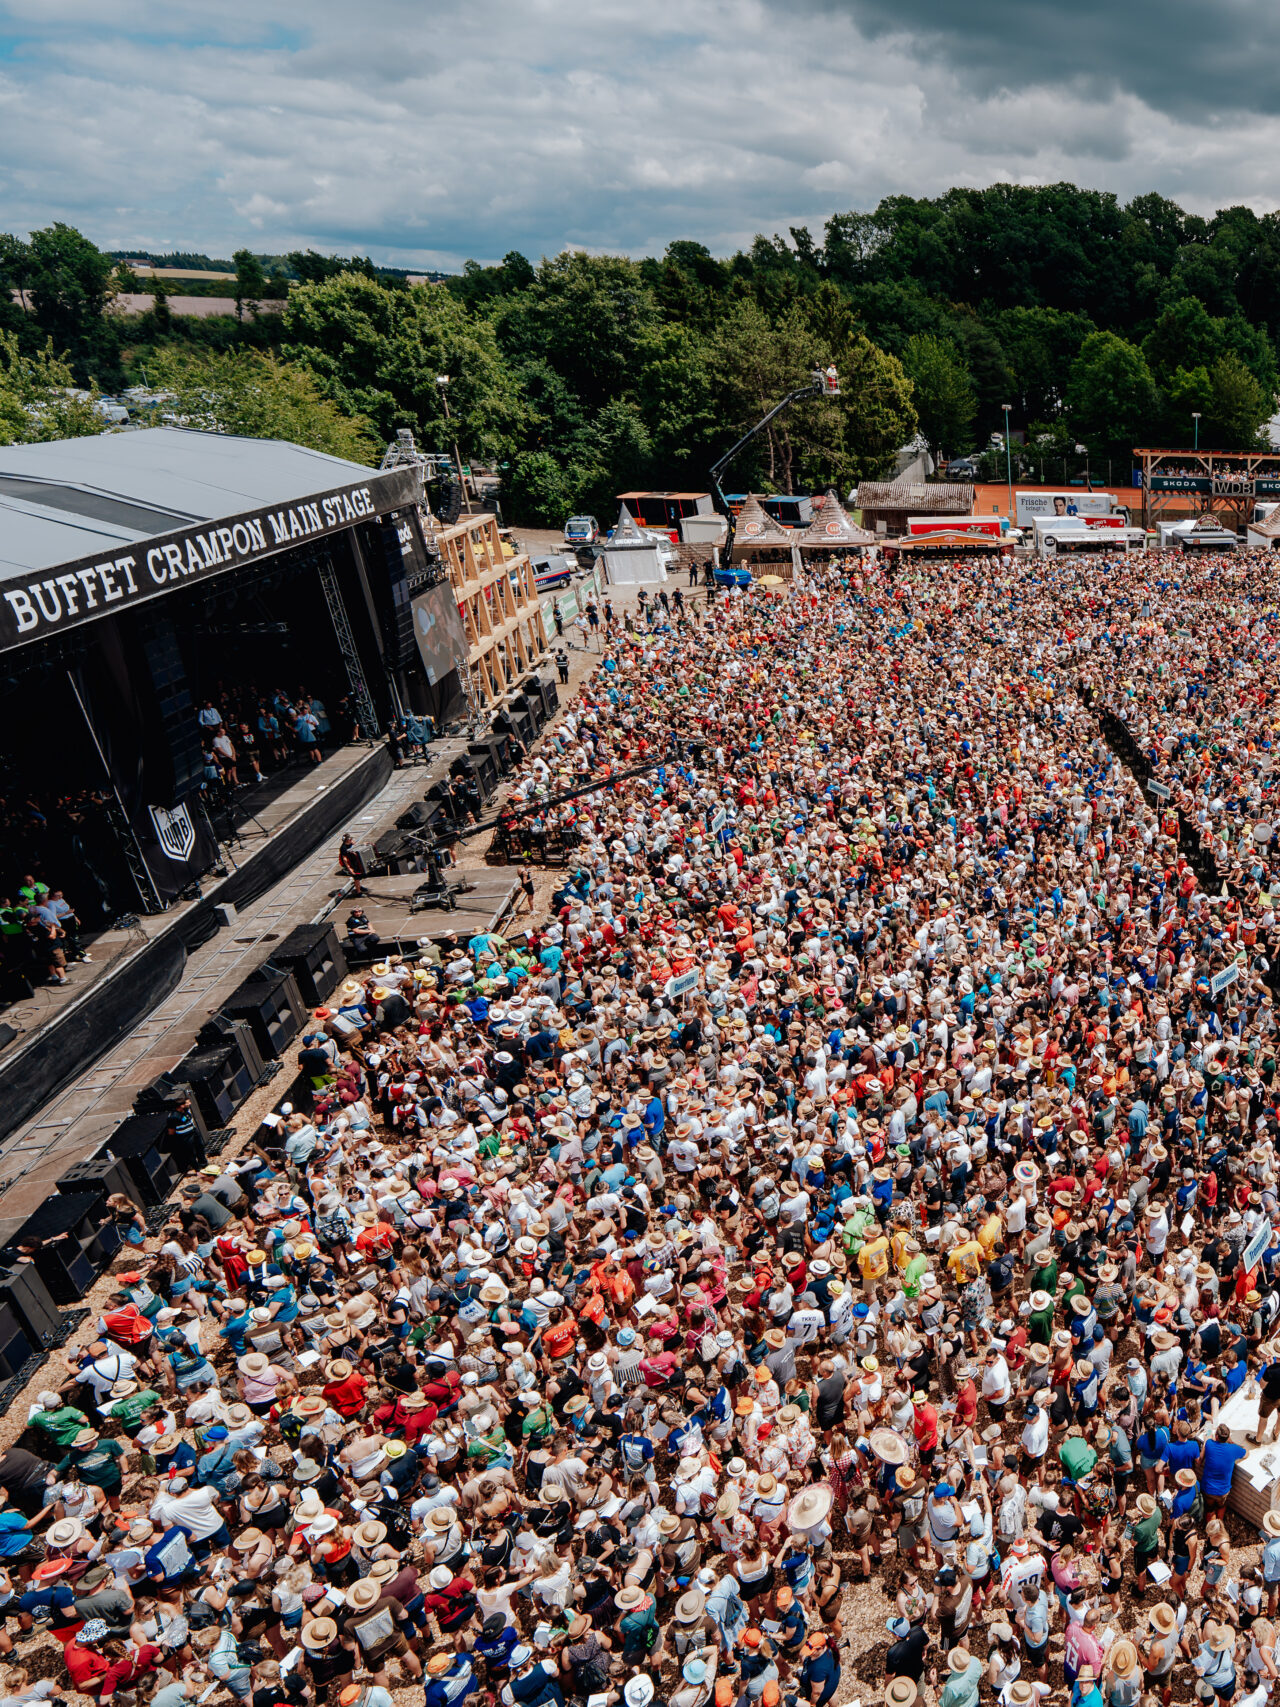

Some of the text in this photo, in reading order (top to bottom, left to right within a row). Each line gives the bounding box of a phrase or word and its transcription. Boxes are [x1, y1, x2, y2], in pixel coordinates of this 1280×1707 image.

[1217, 481, 1252, 494] WDB
[1021, 498, 1048, 506] Frische
[3, 488, 376, 633] BUFFET CRAMPON MAIN STAGE
[803, 1323, 812, 1337] 7
